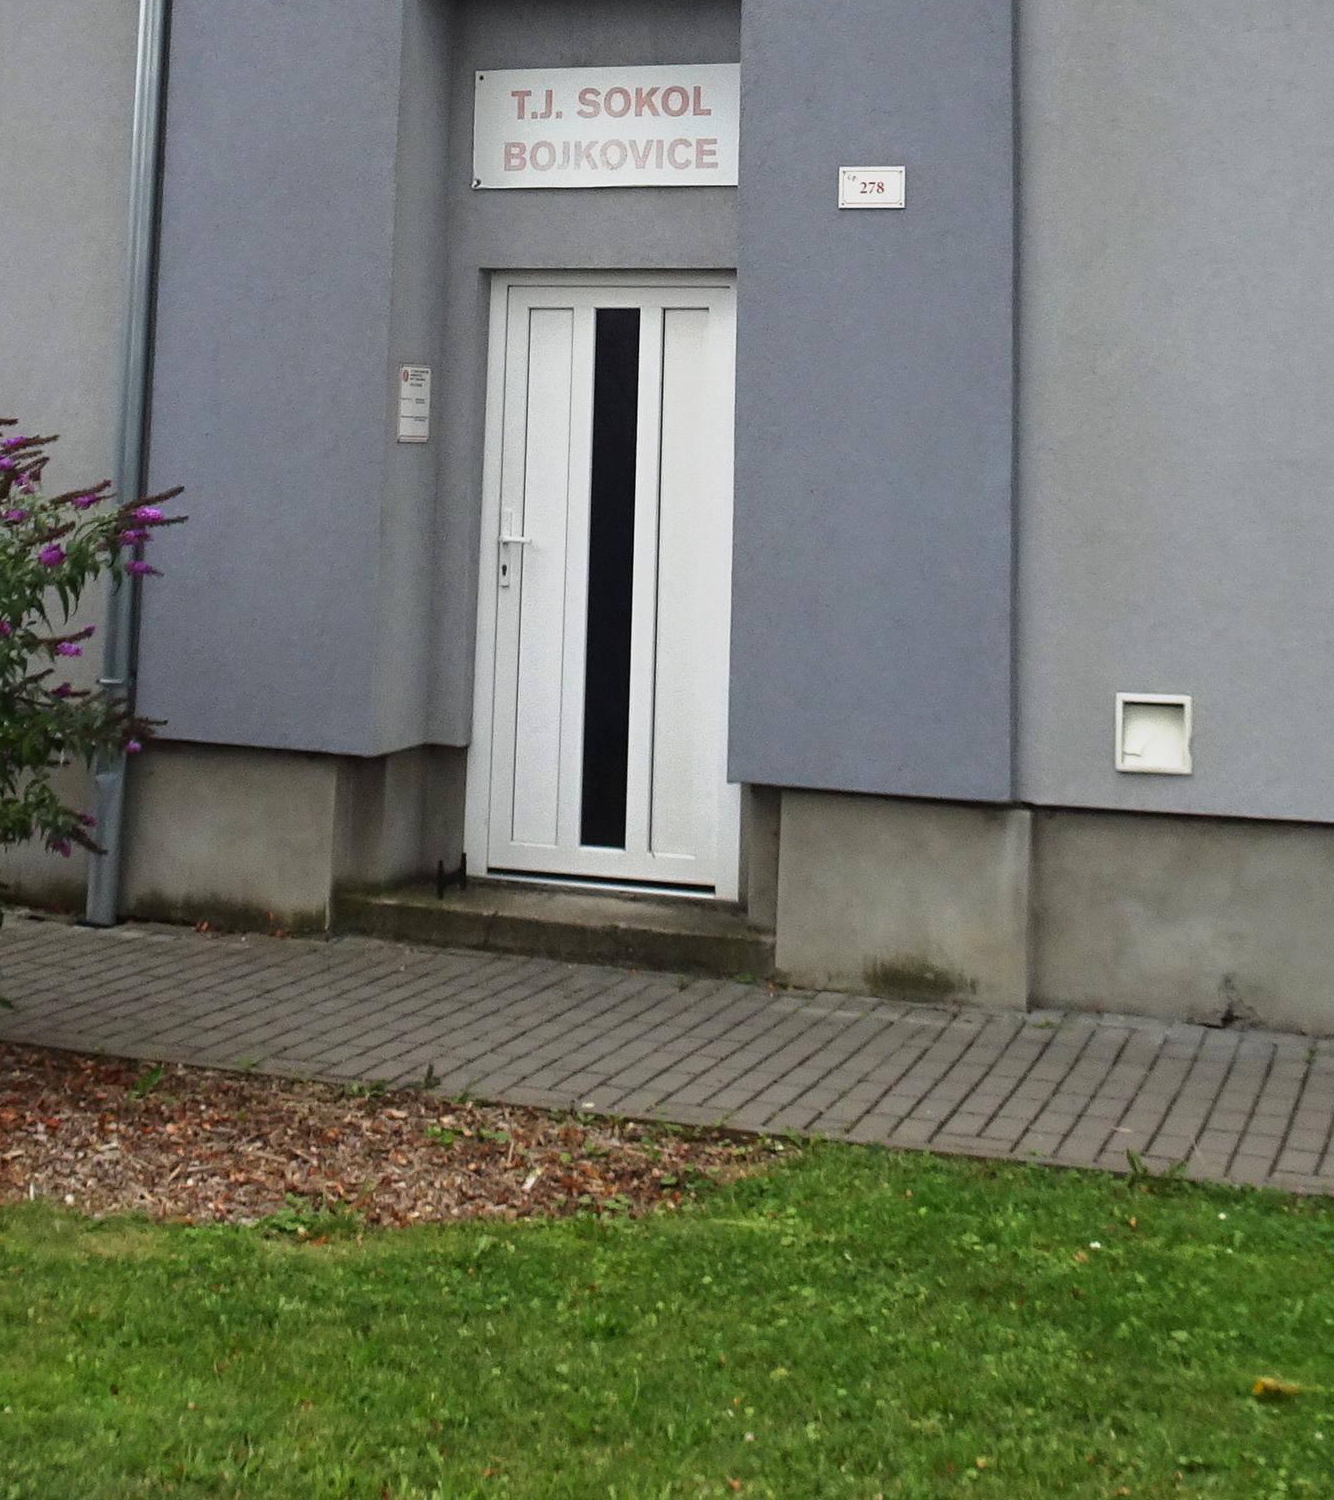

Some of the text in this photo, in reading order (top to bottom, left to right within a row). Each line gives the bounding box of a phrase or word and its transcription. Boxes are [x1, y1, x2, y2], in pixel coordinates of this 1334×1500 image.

[510, 85, 712, 120] T.J. SOKOL
[503, 137, 719, 172] BOJKOVICE
[859, 181, 885, 194] 278
